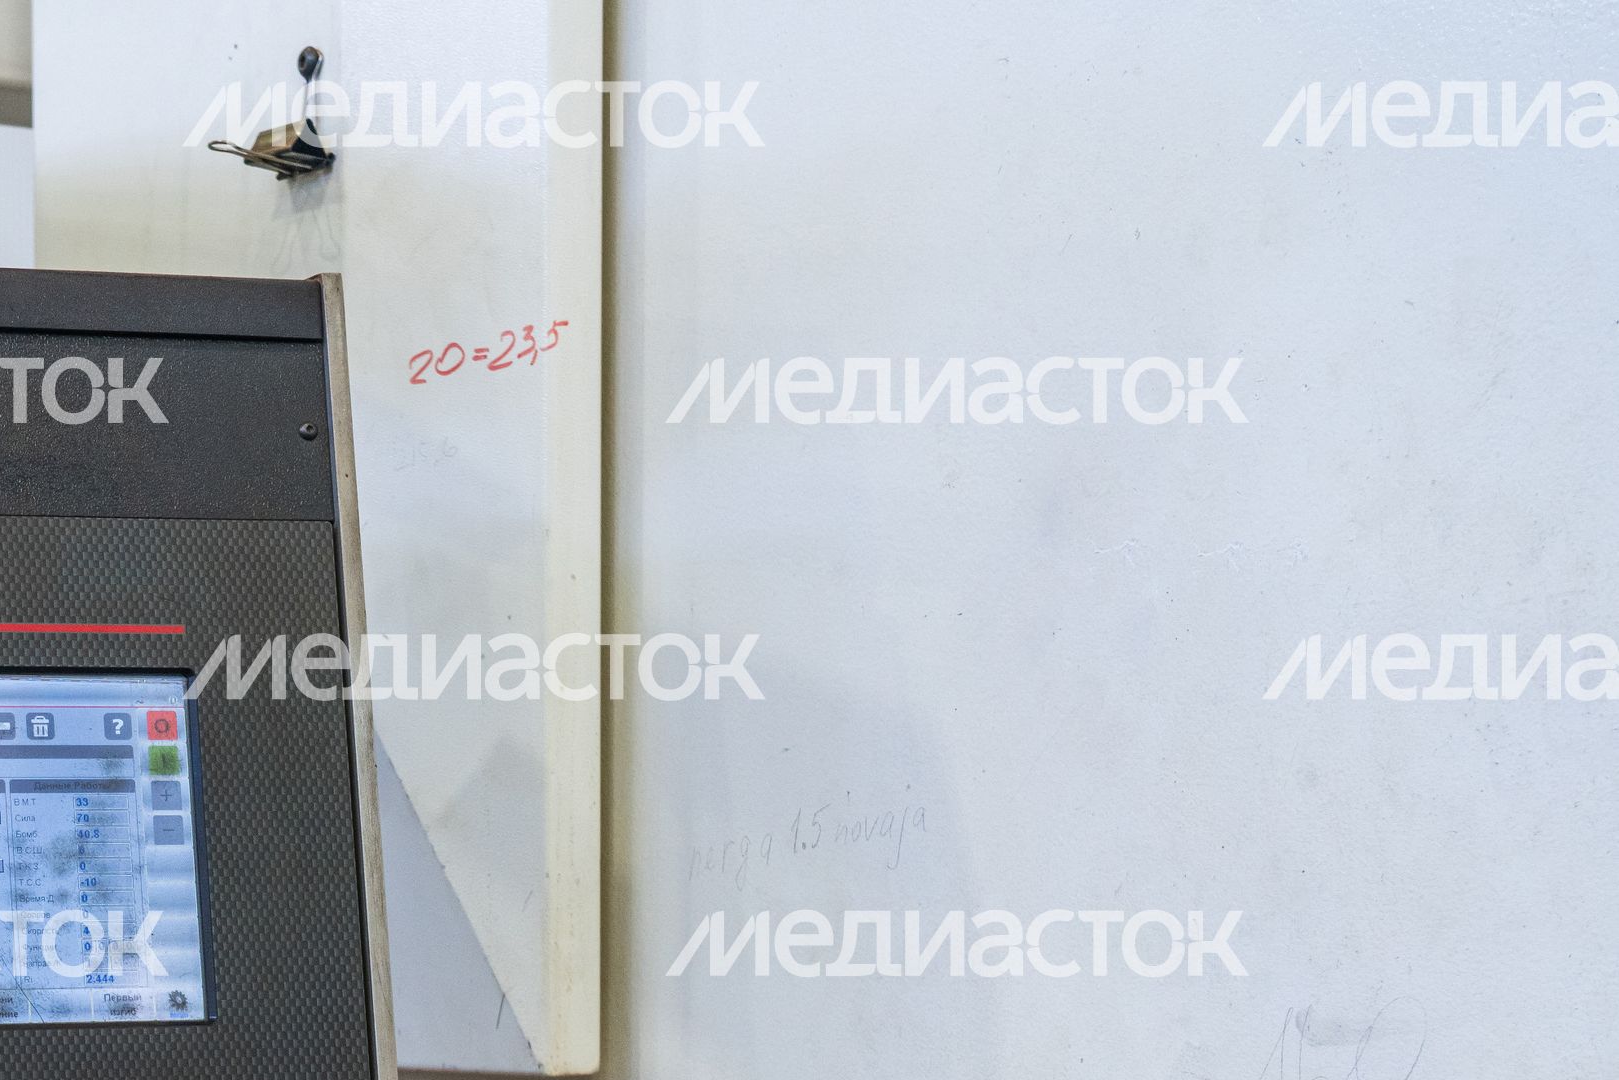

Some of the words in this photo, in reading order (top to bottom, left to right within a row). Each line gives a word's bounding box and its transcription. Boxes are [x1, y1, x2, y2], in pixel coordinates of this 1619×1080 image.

[409, 320, 569, 385] 20=23,5
[76, 798, 89, 807] 33
[77, 814, 90, 823] 70
[81, 878, 97, 887] -10
